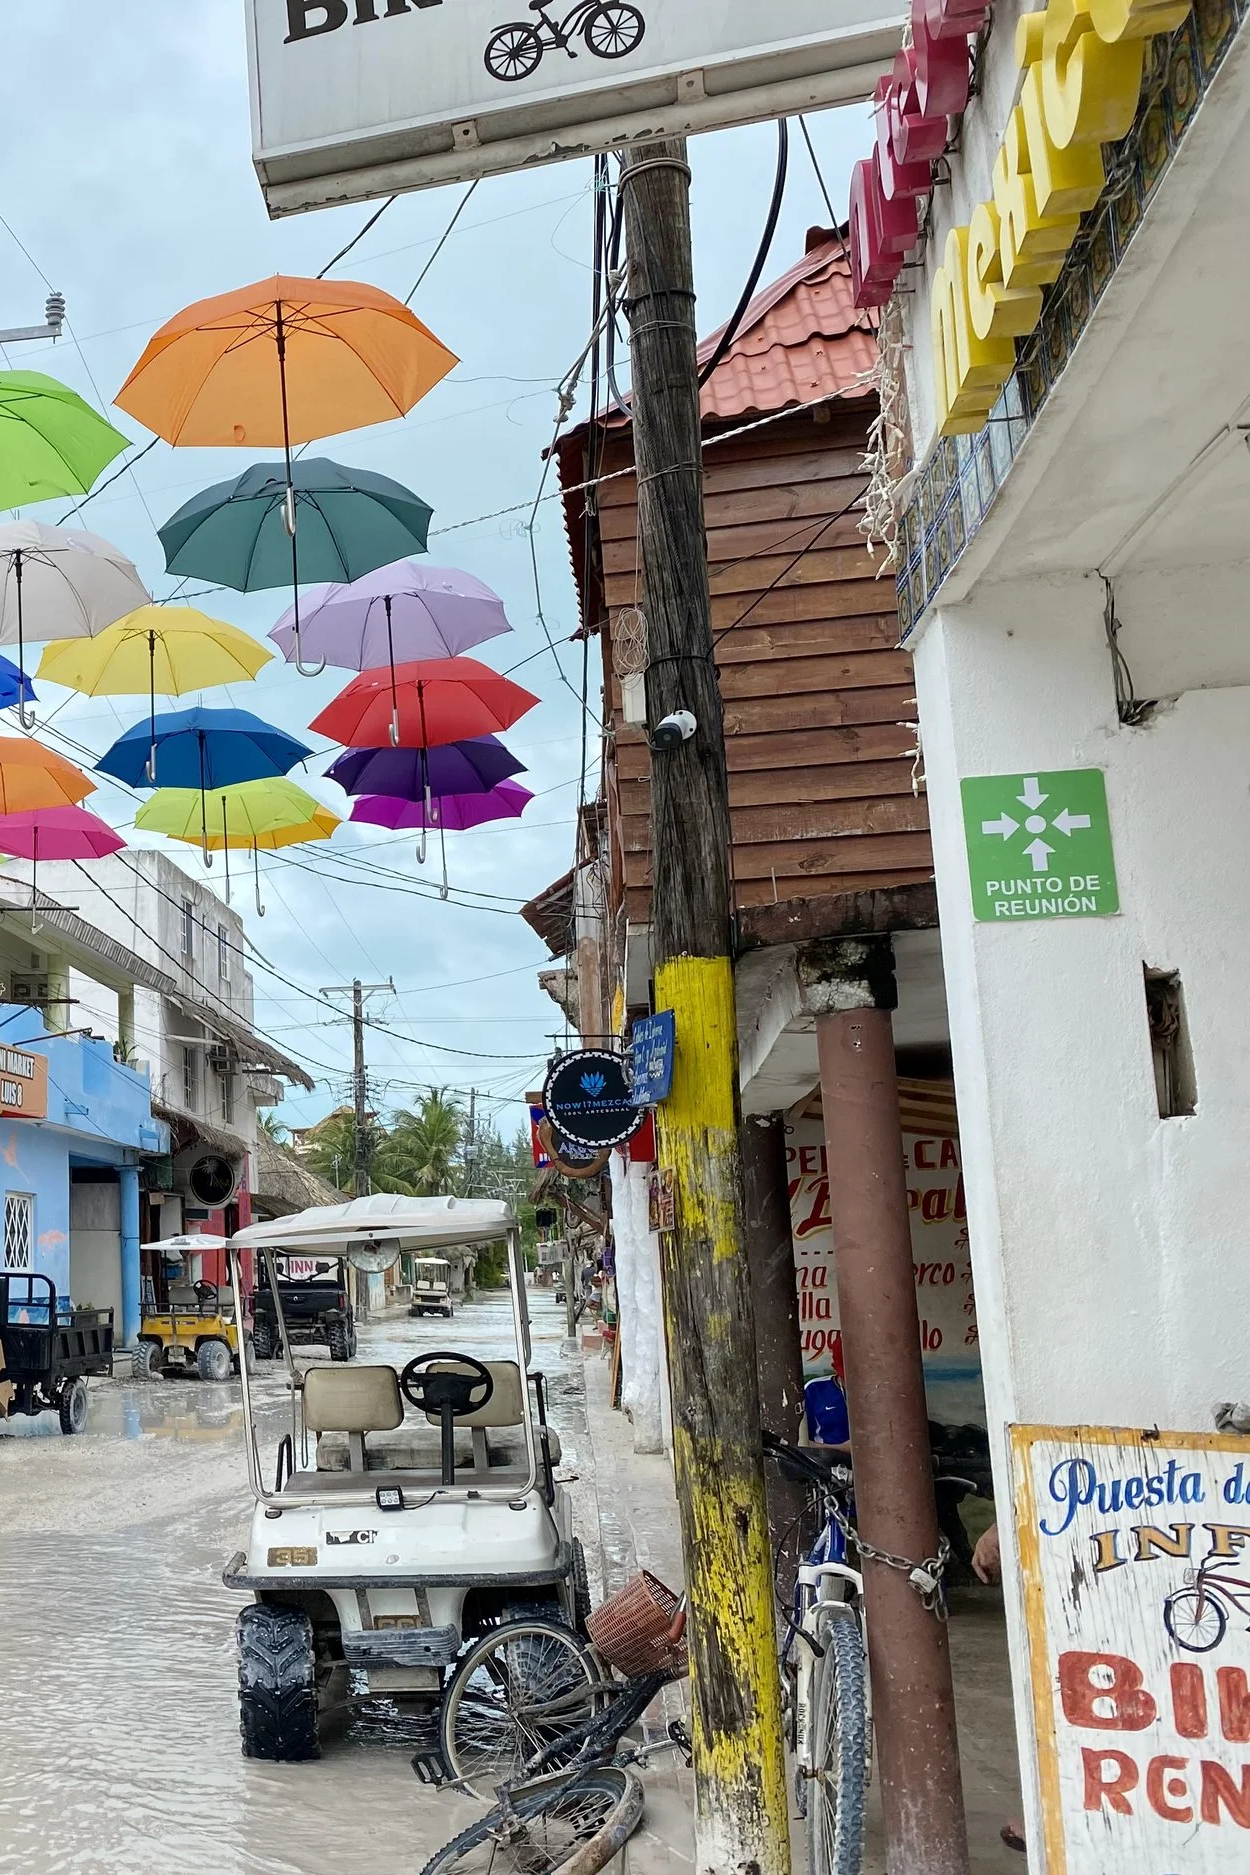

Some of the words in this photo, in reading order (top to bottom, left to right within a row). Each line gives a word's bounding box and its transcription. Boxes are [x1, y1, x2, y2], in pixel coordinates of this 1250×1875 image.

[986, 877, 1062, 896] PUNTO
[1069, 875, 1101, 891] DE
[994, 893, 1097, 916] REUNIÓN
[7, 1049, 35, 1080] MARKET
[1, 1078, 17, 1106] LUIS
[17, 1083, 23, 1107] 8
[290, 1260, 313, 1274] INN
[1039, 1457, 1205, 1536] Puesta
